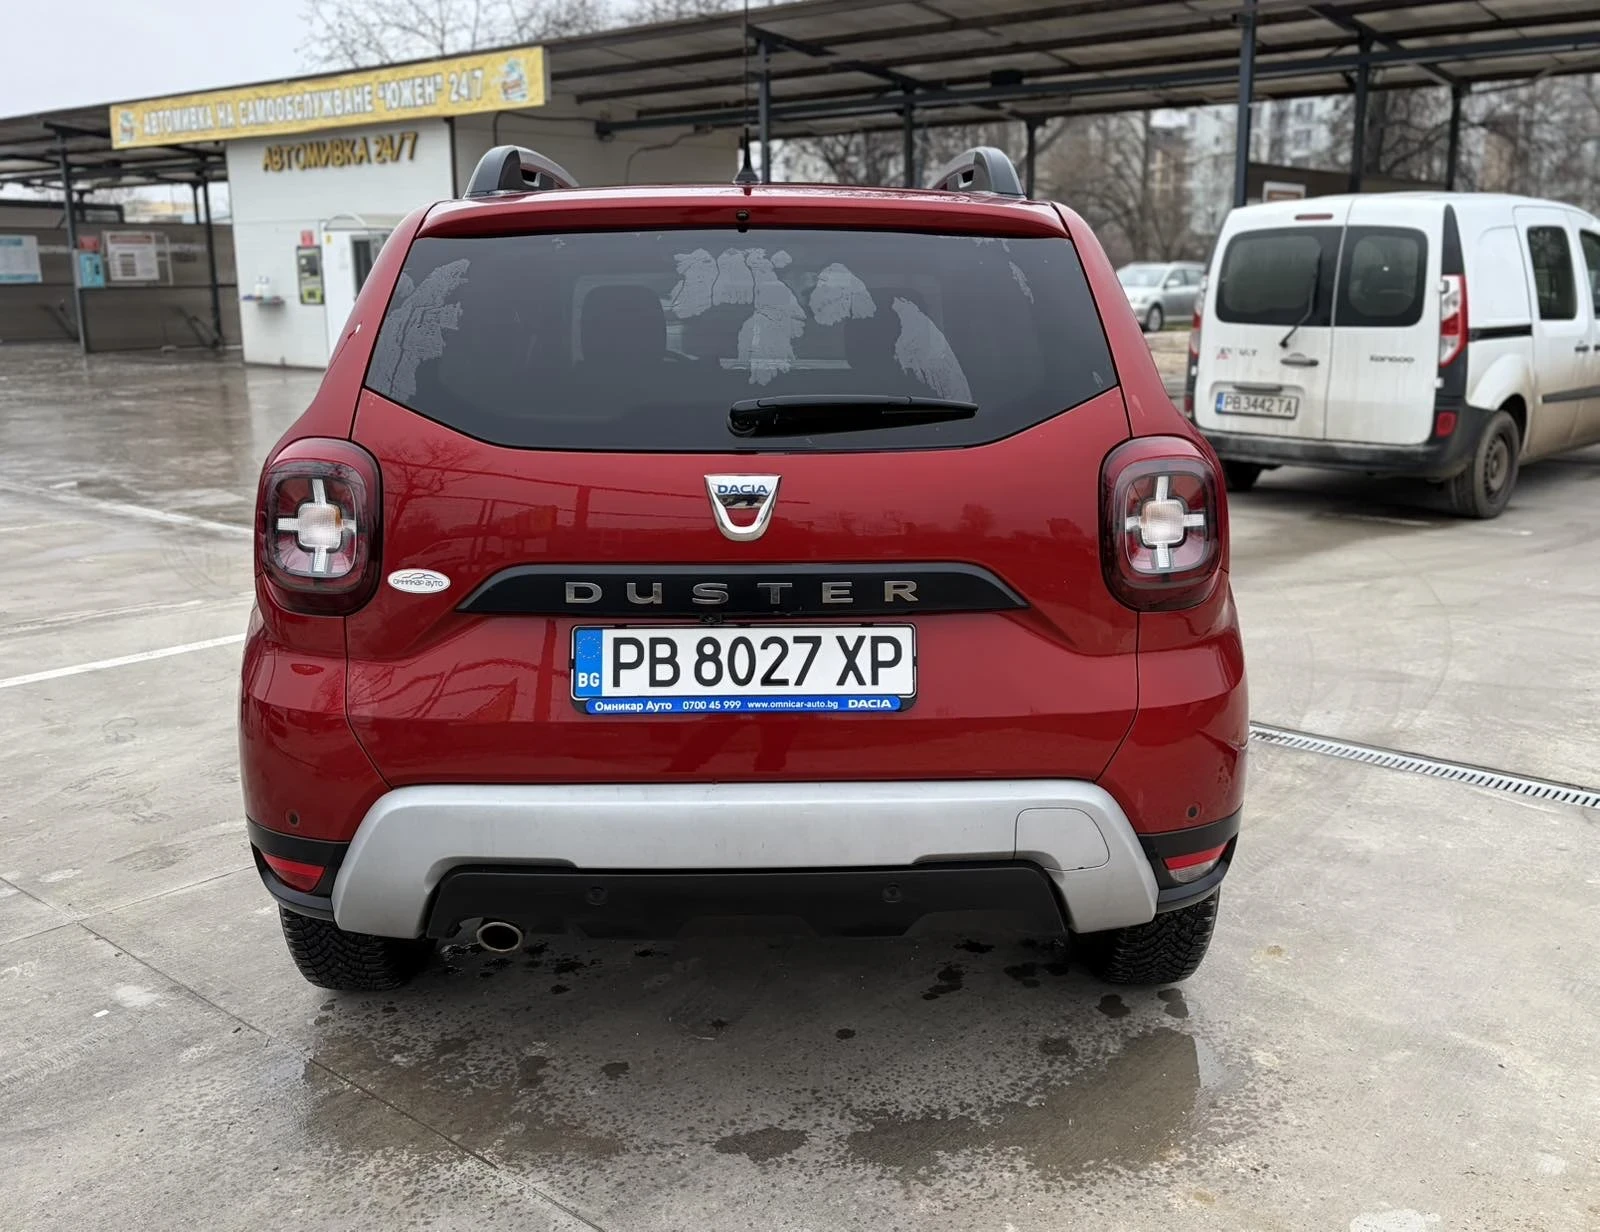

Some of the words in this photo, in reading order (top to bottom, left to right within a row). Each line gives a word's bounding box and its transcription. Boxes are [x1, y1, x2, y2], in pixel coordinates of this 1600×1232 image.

[143, 105, 215, 136] АВТОМИВКА
[216, 102, 236, 129] НА
[263, 136, 372, 172] АВТОМИВКА
[373, 131, 419, 164] 24/7
[1243, 396, 1274, 413] 3442
[717, 484, 769, 494] DACIA
[565, 580, 920, 605] DUSTER
[612, 636, 681, 688] PB
[694, 635, 823, 688] 8027
[835, 634, 903, 687] XP
[577, 672, 600, 688] BG
[594, 701, 644, 712] Омникар
[645, 701, 673, 712] Ауто
[682, 700, 707, 710] 0700
[708, 700, 722, 710] 45
[723, 700, 742, 710] 999
[747, 699, 839, 710] www.omnicar-auto.bg
[847, 699, 892, 709] DACIA
